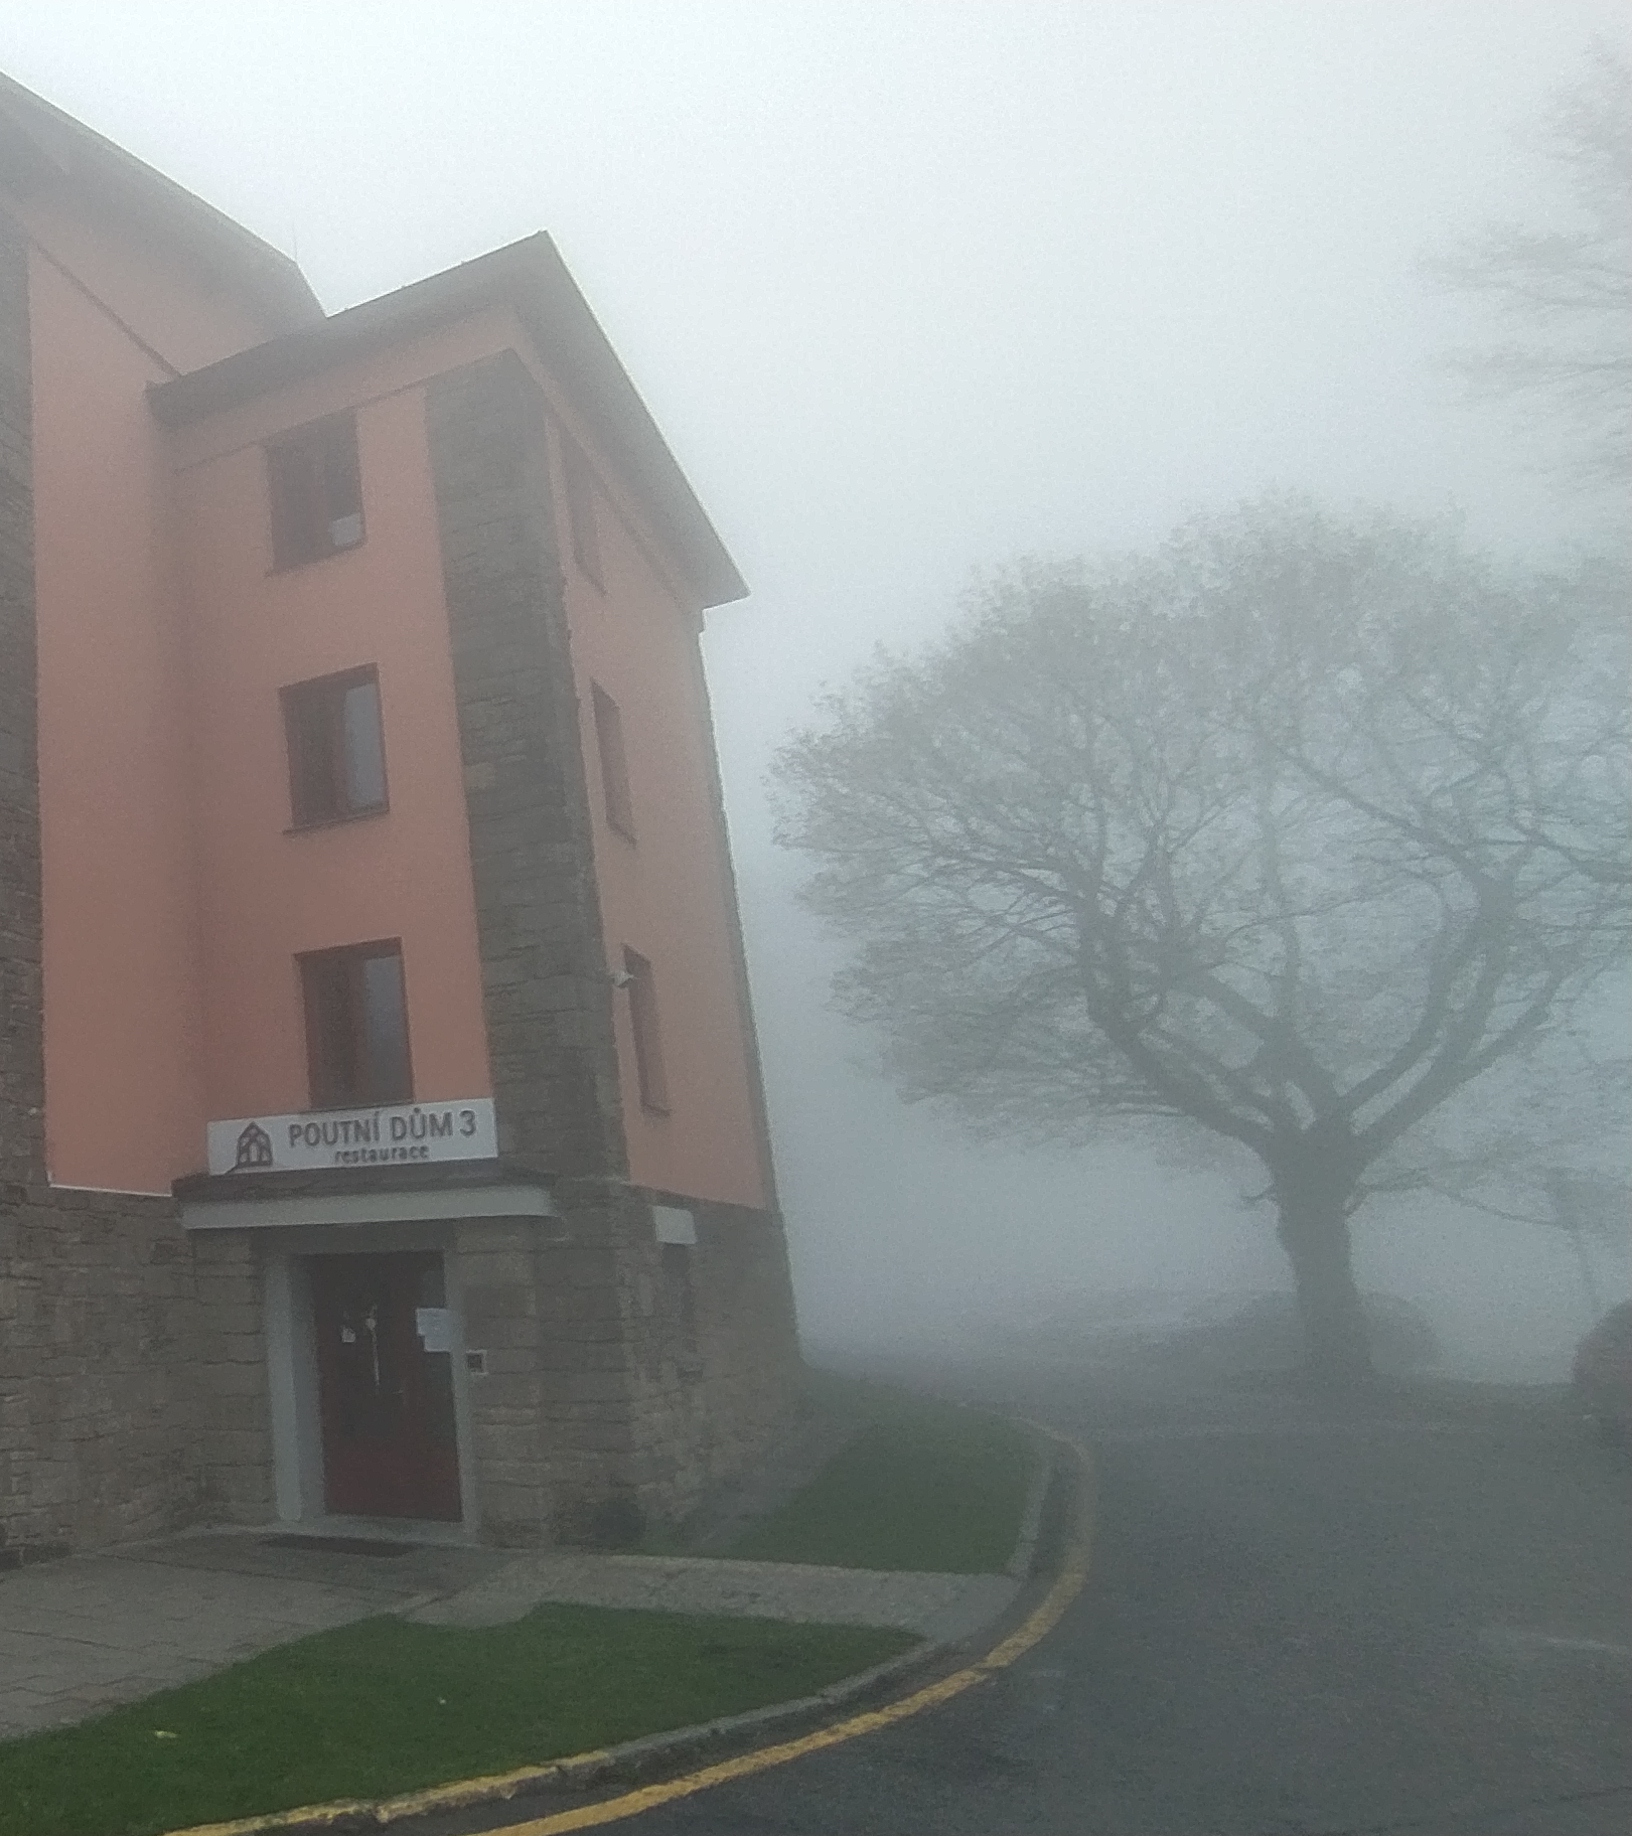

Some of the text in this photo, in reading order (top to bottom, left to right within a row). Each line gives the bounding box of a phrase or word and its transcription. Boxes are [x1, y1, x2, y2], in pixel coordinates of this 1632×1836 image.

[288, 1107, 476, 1147] POUTNÍ DŮM 3
[334, 1145, 429, 1163] restaurace
